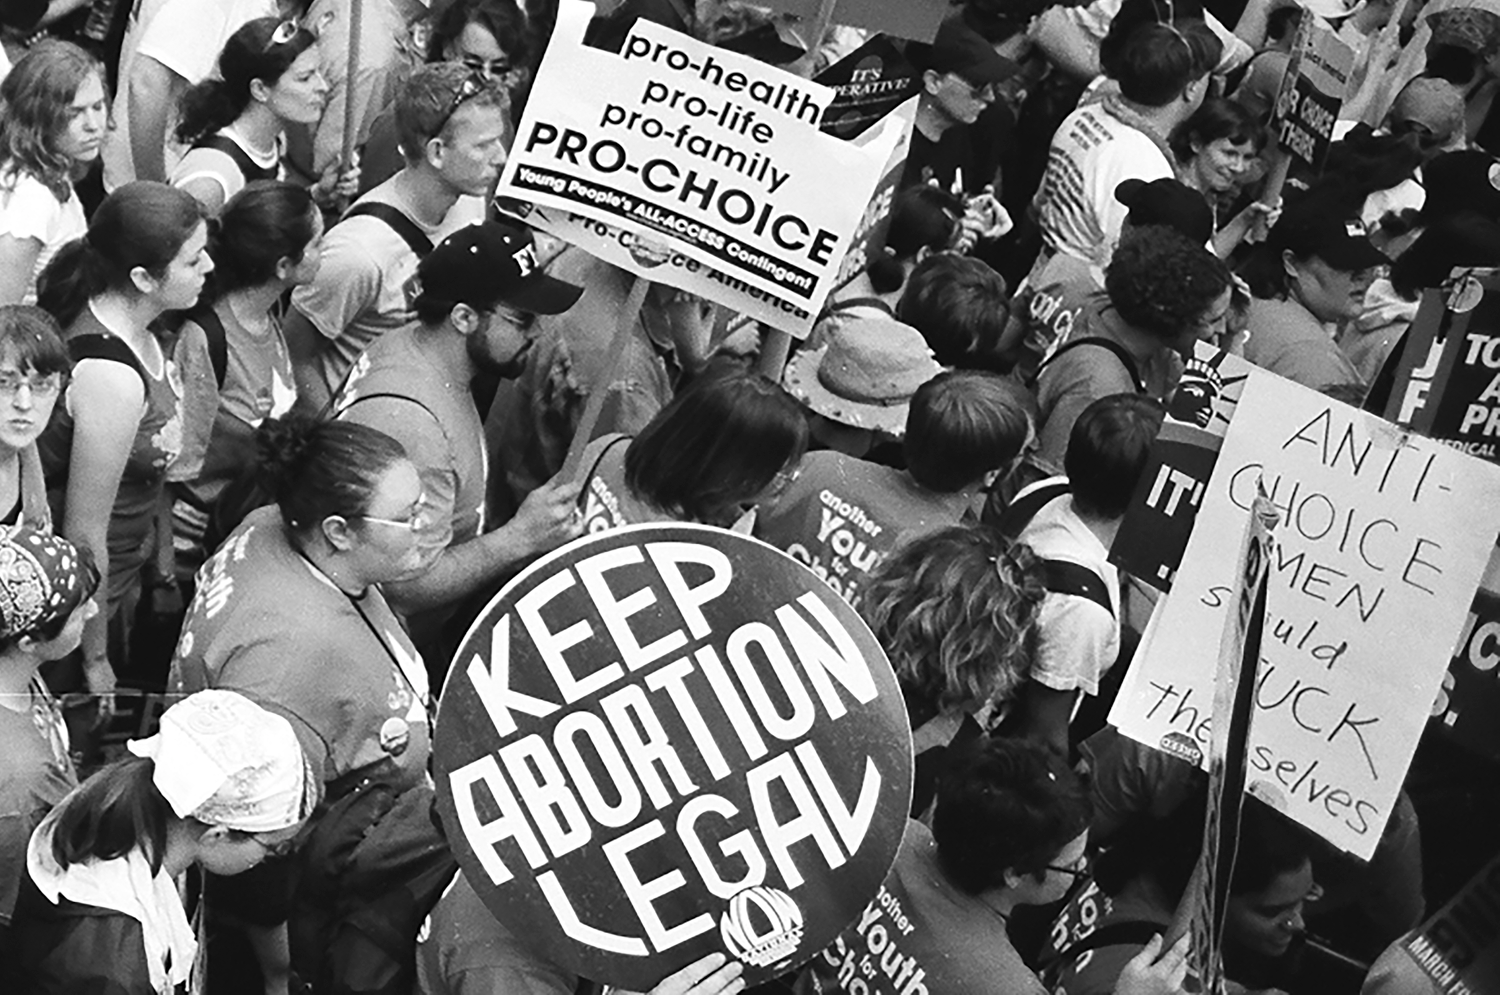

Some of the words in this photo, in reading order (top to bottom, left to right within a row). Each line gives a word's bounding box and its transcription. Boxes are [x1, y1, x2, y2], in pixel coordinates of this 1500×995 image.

[623, 33, 821, 126] pro-health
[641, 78, 775, 145] pro-life
[826, 75, 912, 98] PERATIVE!
[850, 66, 882, 84] IT'S
[523, 120, 841, 268] PRO-CHOICE
[599, 101, 791, 196] pro-family
[518, 166, 567, 195] Young
[566, 178, 633, 214] People's
[633, 202, 726, 252] ALL-ACCESS
[726, 243, 814, 293] Contingent
[1145, 463, 1206, 518] IT'
[1281, 407, 1452, 504] ANTI-
[819, 488, 883, 538] another
[1229, 463, 1445, 597] CHOICE
[466, 540, 734, 739] KEEP
[1200, 584, 1348, 672] suld
[447, 589, 881, 888] ABORTION
[535, 739, 884, 958] LEGAL
[856, 901, 931, 995] Youth
[1407, 935, 1457, 987] MARCH
